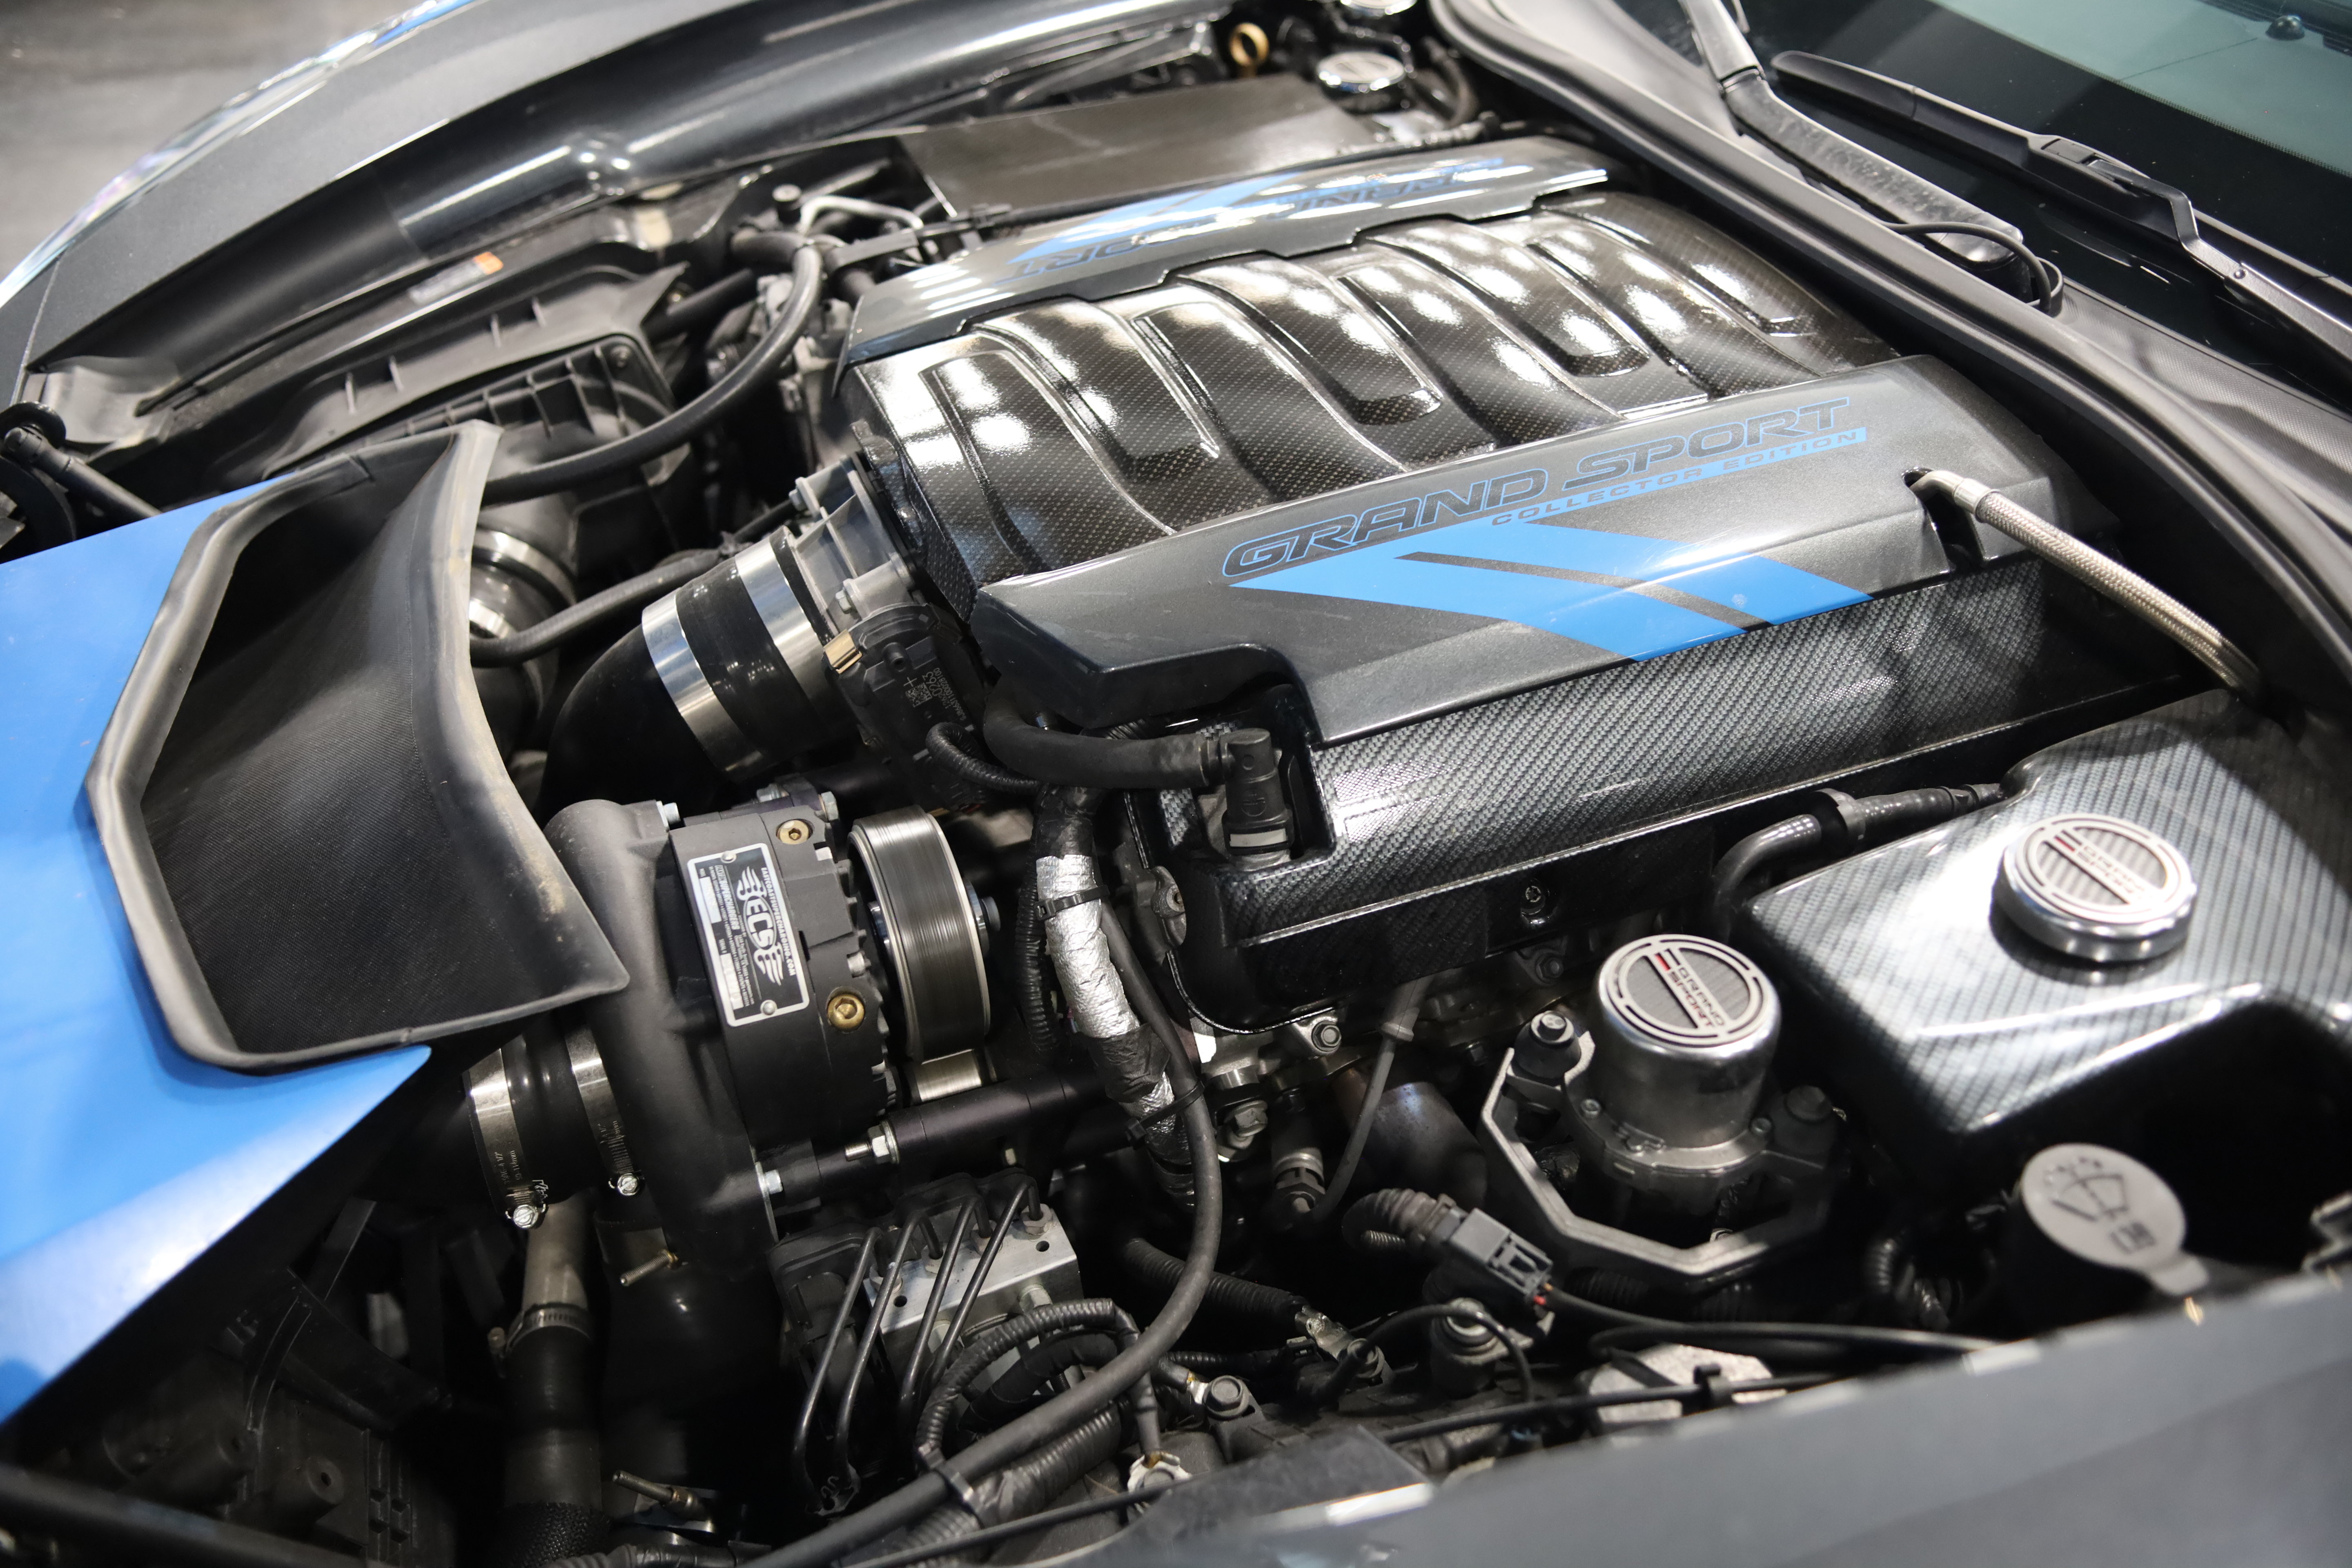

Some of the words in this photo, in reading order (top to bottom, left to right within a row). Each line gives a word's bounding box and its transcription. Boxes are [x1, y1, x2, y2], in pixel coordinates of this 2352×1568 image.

[1222, 469, 1548, 579] GRAND
[1562, 396, 1850, 490] SPORT
[1491, 468, 1704, 527] COLLECTOR
[1723, 429, 1858, 470] EDITION
[922, 671, 951, 709] 12620263
[2083, 846, 2152, 898] GRAN
[747, 899, 775, 949] ECS
[761, 867, 796, 976] EASTCOASTSUPERCHARGING.COM
[1668, 971, 1714, 1027] SPORT
[1678, 967, 1724, 1027] GRAND
